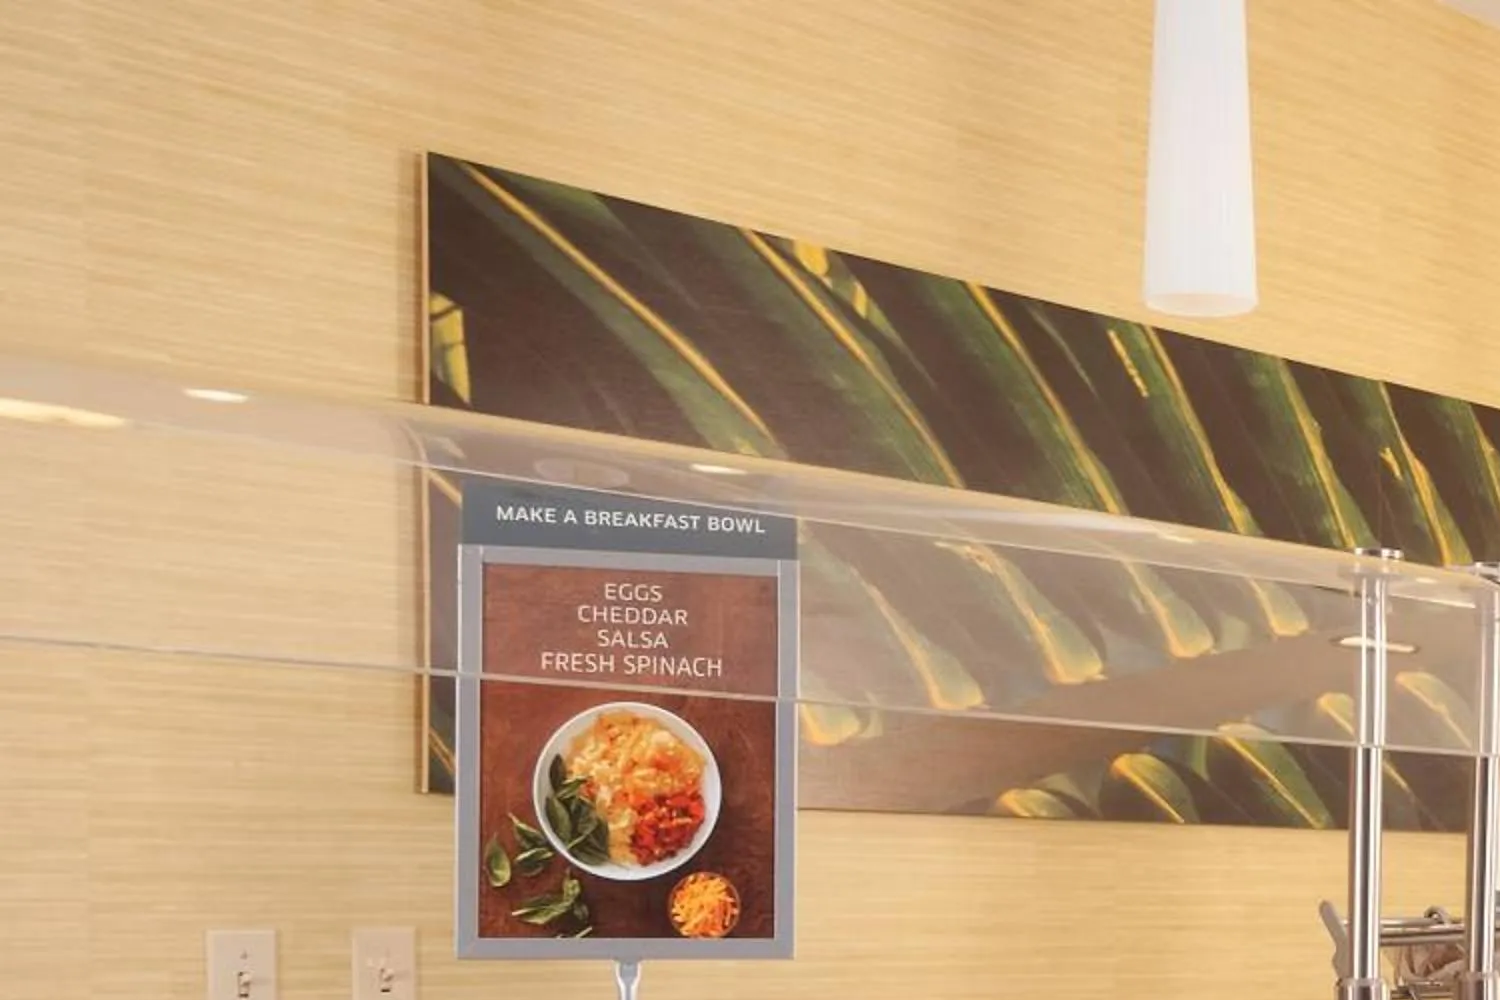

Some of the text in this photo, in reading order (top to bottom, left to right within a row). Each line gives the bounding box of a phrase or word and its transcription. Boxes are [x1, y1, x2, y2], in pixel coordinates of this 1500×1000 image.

[496, 505, 766, 533] MAKE A BREAKFAST BOWL
[604, 583, 663, 601] EGGS
[577, 605, 688, 625] CHEDDAR
[597, 629, 669, 649] SALSA
[541, 652, 722, 677] FRESH SPINACH
